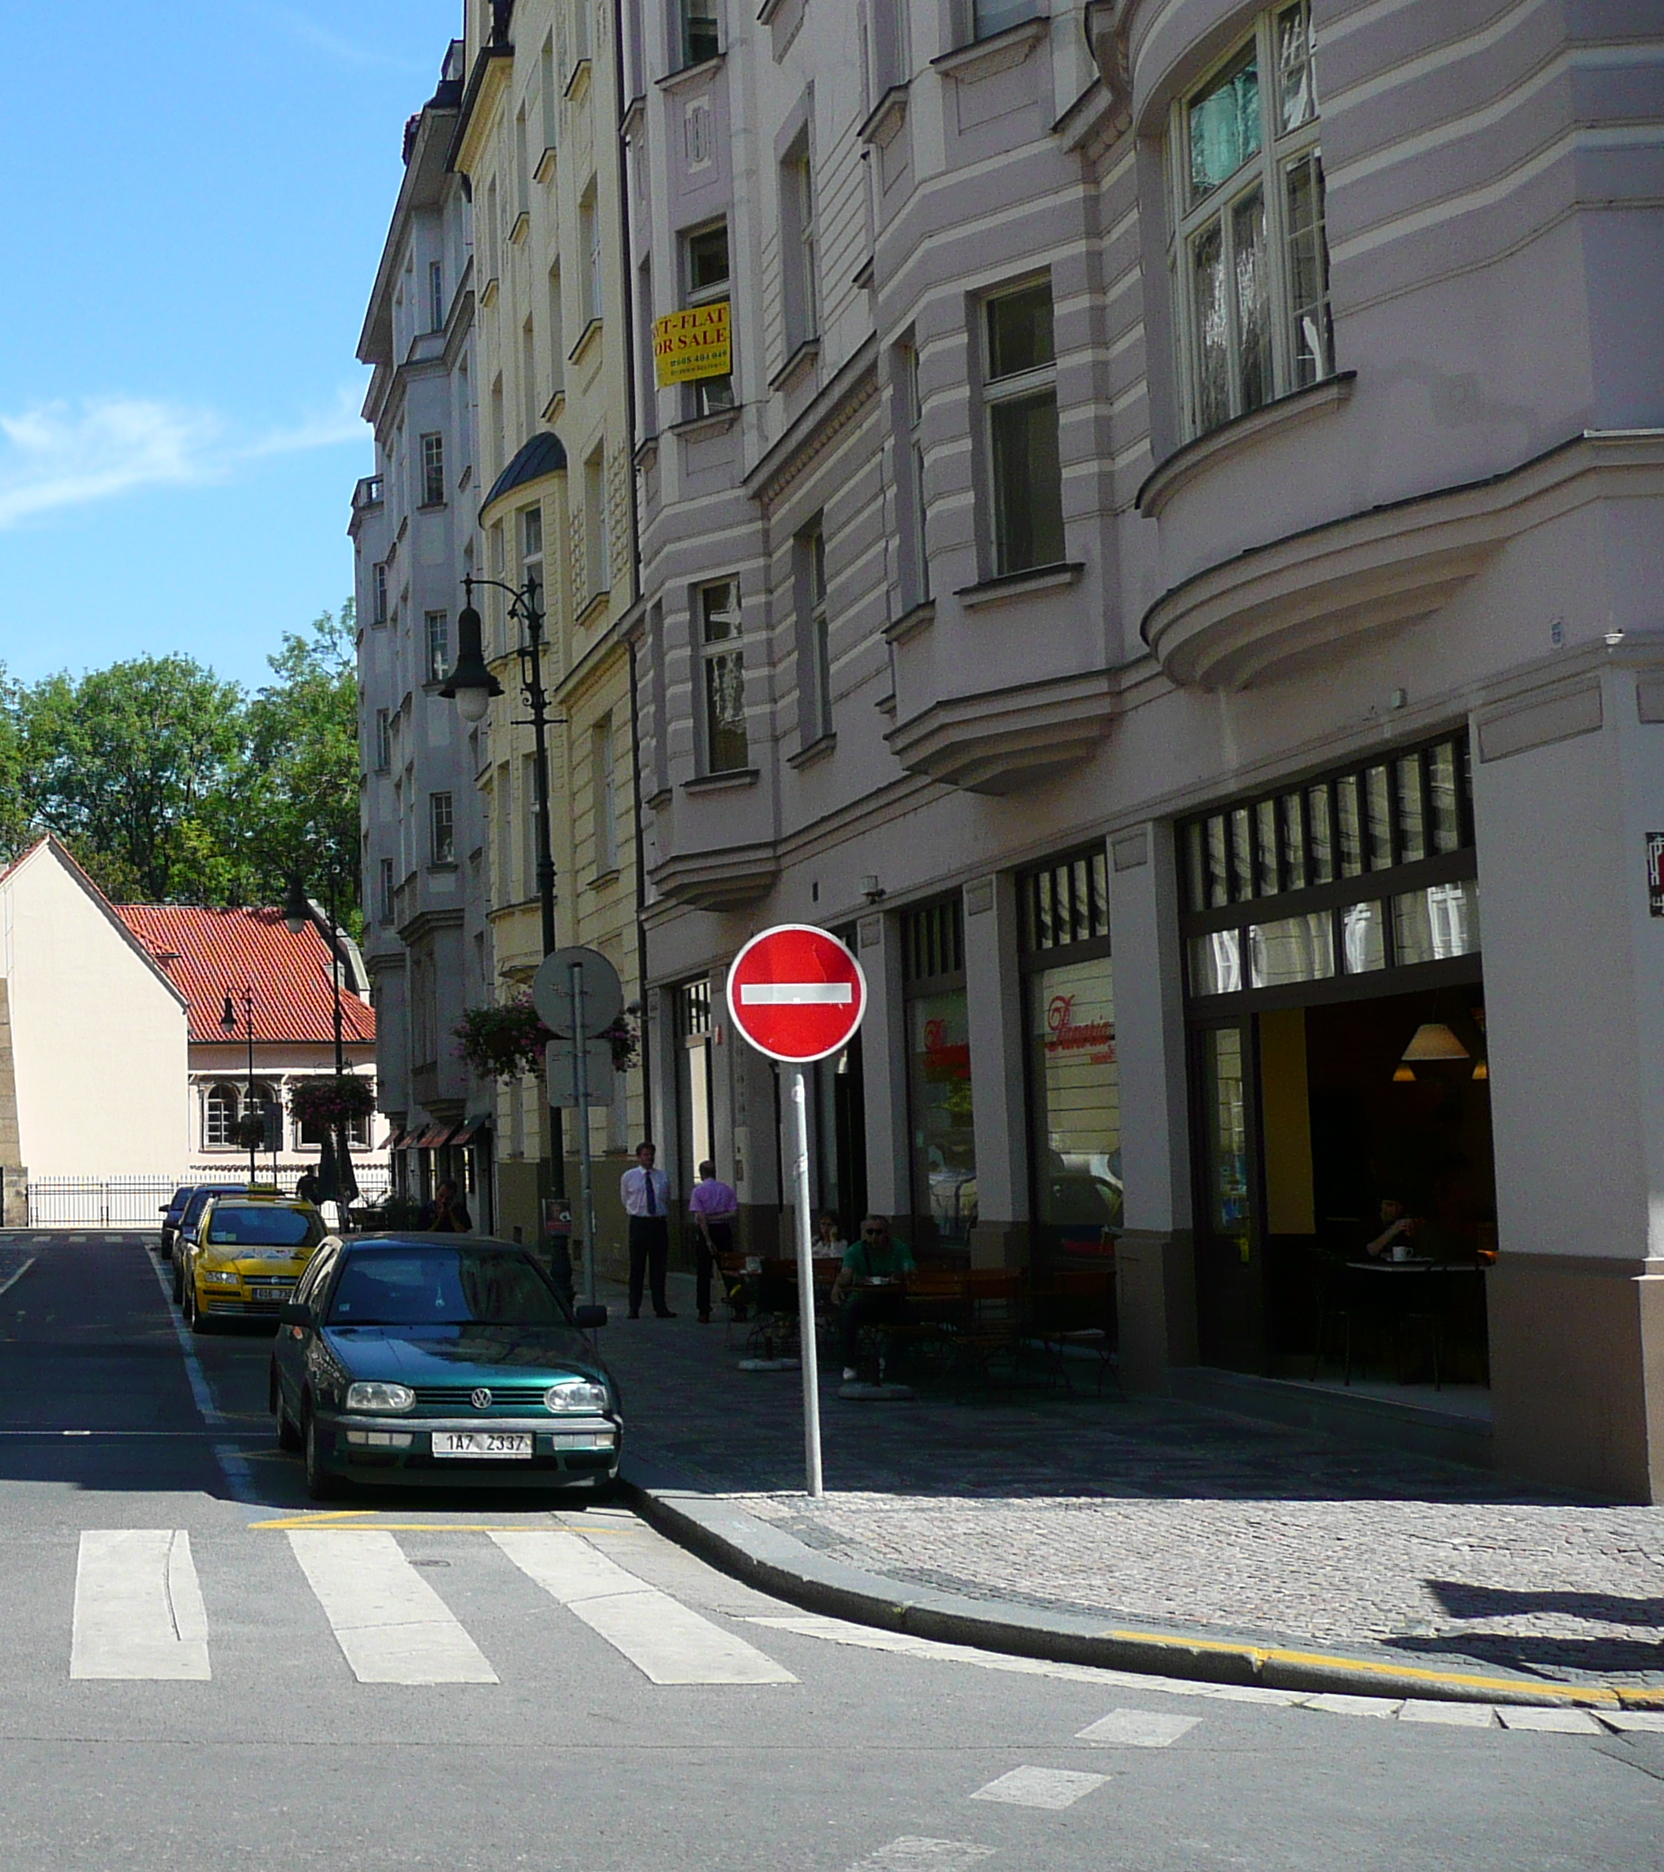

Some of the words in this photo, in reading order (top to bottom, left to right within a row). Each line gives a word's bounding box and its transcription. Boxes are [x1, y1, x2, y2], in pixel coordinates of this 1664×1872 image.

[678, 328, 727, 350] SALE
[446, 1434, 474, 1450] 1A7
[486, 1435, 525, 1451] 2337
